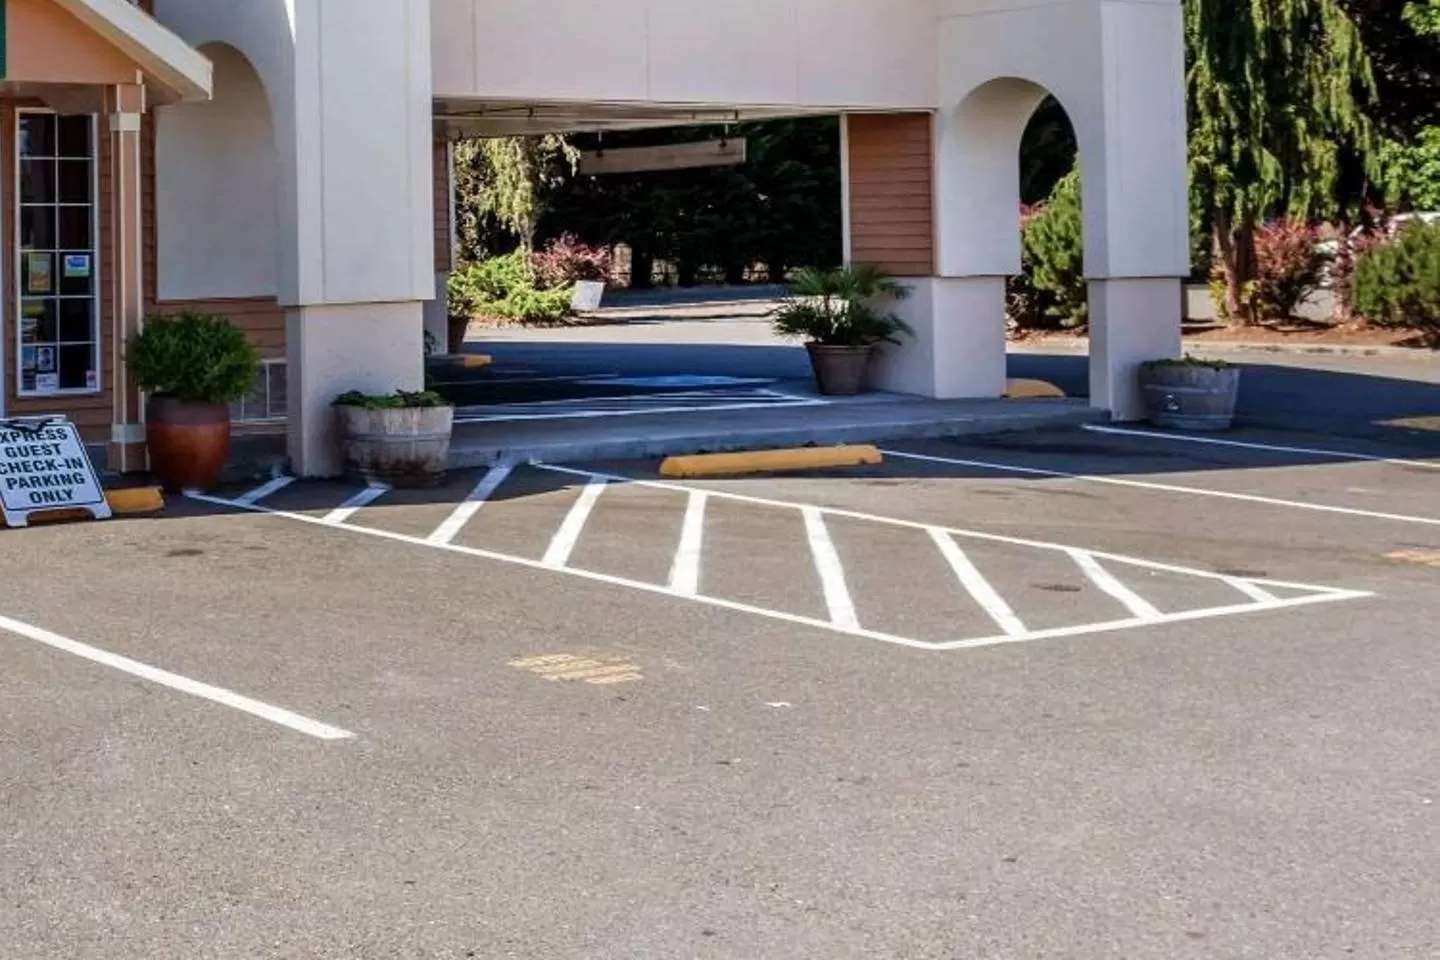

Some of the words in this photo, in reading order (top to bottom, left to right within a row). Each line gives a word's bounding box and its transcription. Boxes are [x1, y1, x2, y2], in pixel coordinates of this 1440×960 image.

[4, 443, 62, 458] GUEST
[5, 472, 85, 490] PARKING
[29, 489, 75, 504] ONLY
